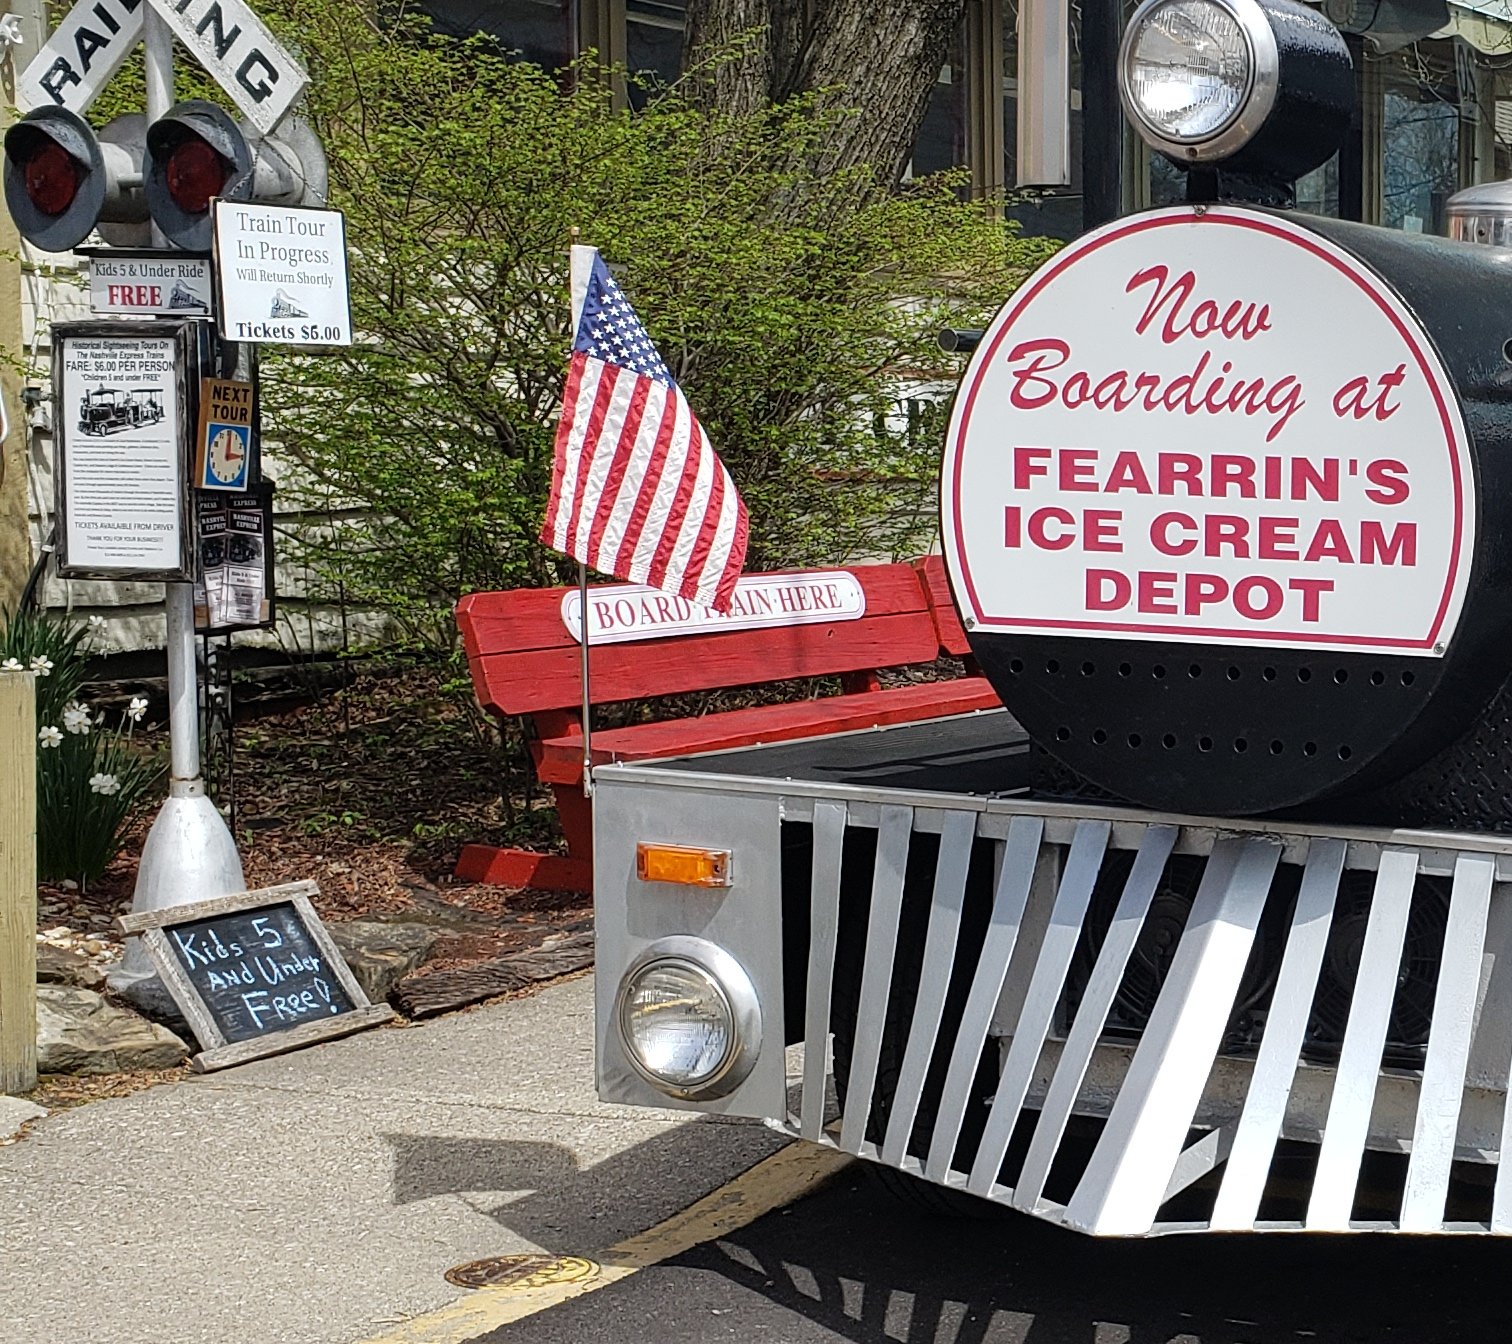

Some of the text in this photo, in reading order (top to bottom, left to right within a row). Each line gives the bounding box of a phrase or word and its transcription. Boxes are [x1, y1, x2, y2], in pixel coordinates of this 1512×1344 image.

[237, 212, 326, 237] Train Tour
[237, 239, 255, 259] In
[95, 263, 204, 278] Kids 5 & Under Ride
[236, 268, 334, 289] Will Return Shortly
[107, 284, 163, 307] FREE
[1125, 264, 1272, 344] Now
[235, 322, 341, 341] Tickets $6.00
[71, 341, 169, 351] Historical Sightseeing Tours On
[76, 351, 165, 360] The Nashville Express Trains
[66, 360, 175, 372] FARE: $6.00 PER PERSON
[212, 385, 250, 403] NEXT
[1006, 338, 1307, 443] Boarding
[1332, 363, 1408, 422] at
[212, 404, 249, 422] TOUR
[1012, 446, 1411, 506] FEARRIN'S
[74, 521, 174, 531] TICKETS AVAILABLE FROM DRIVER
[1003, 505, 1418, 567] ICE CREAM
[1084, 567, 1335, 623] DEPOT
[594, 595, 692, 630] BOARD
[780, 583, 843, 613] HERE
[172, 917, 283, 970] Kids 5
[254, 952, 320, 985] Under
